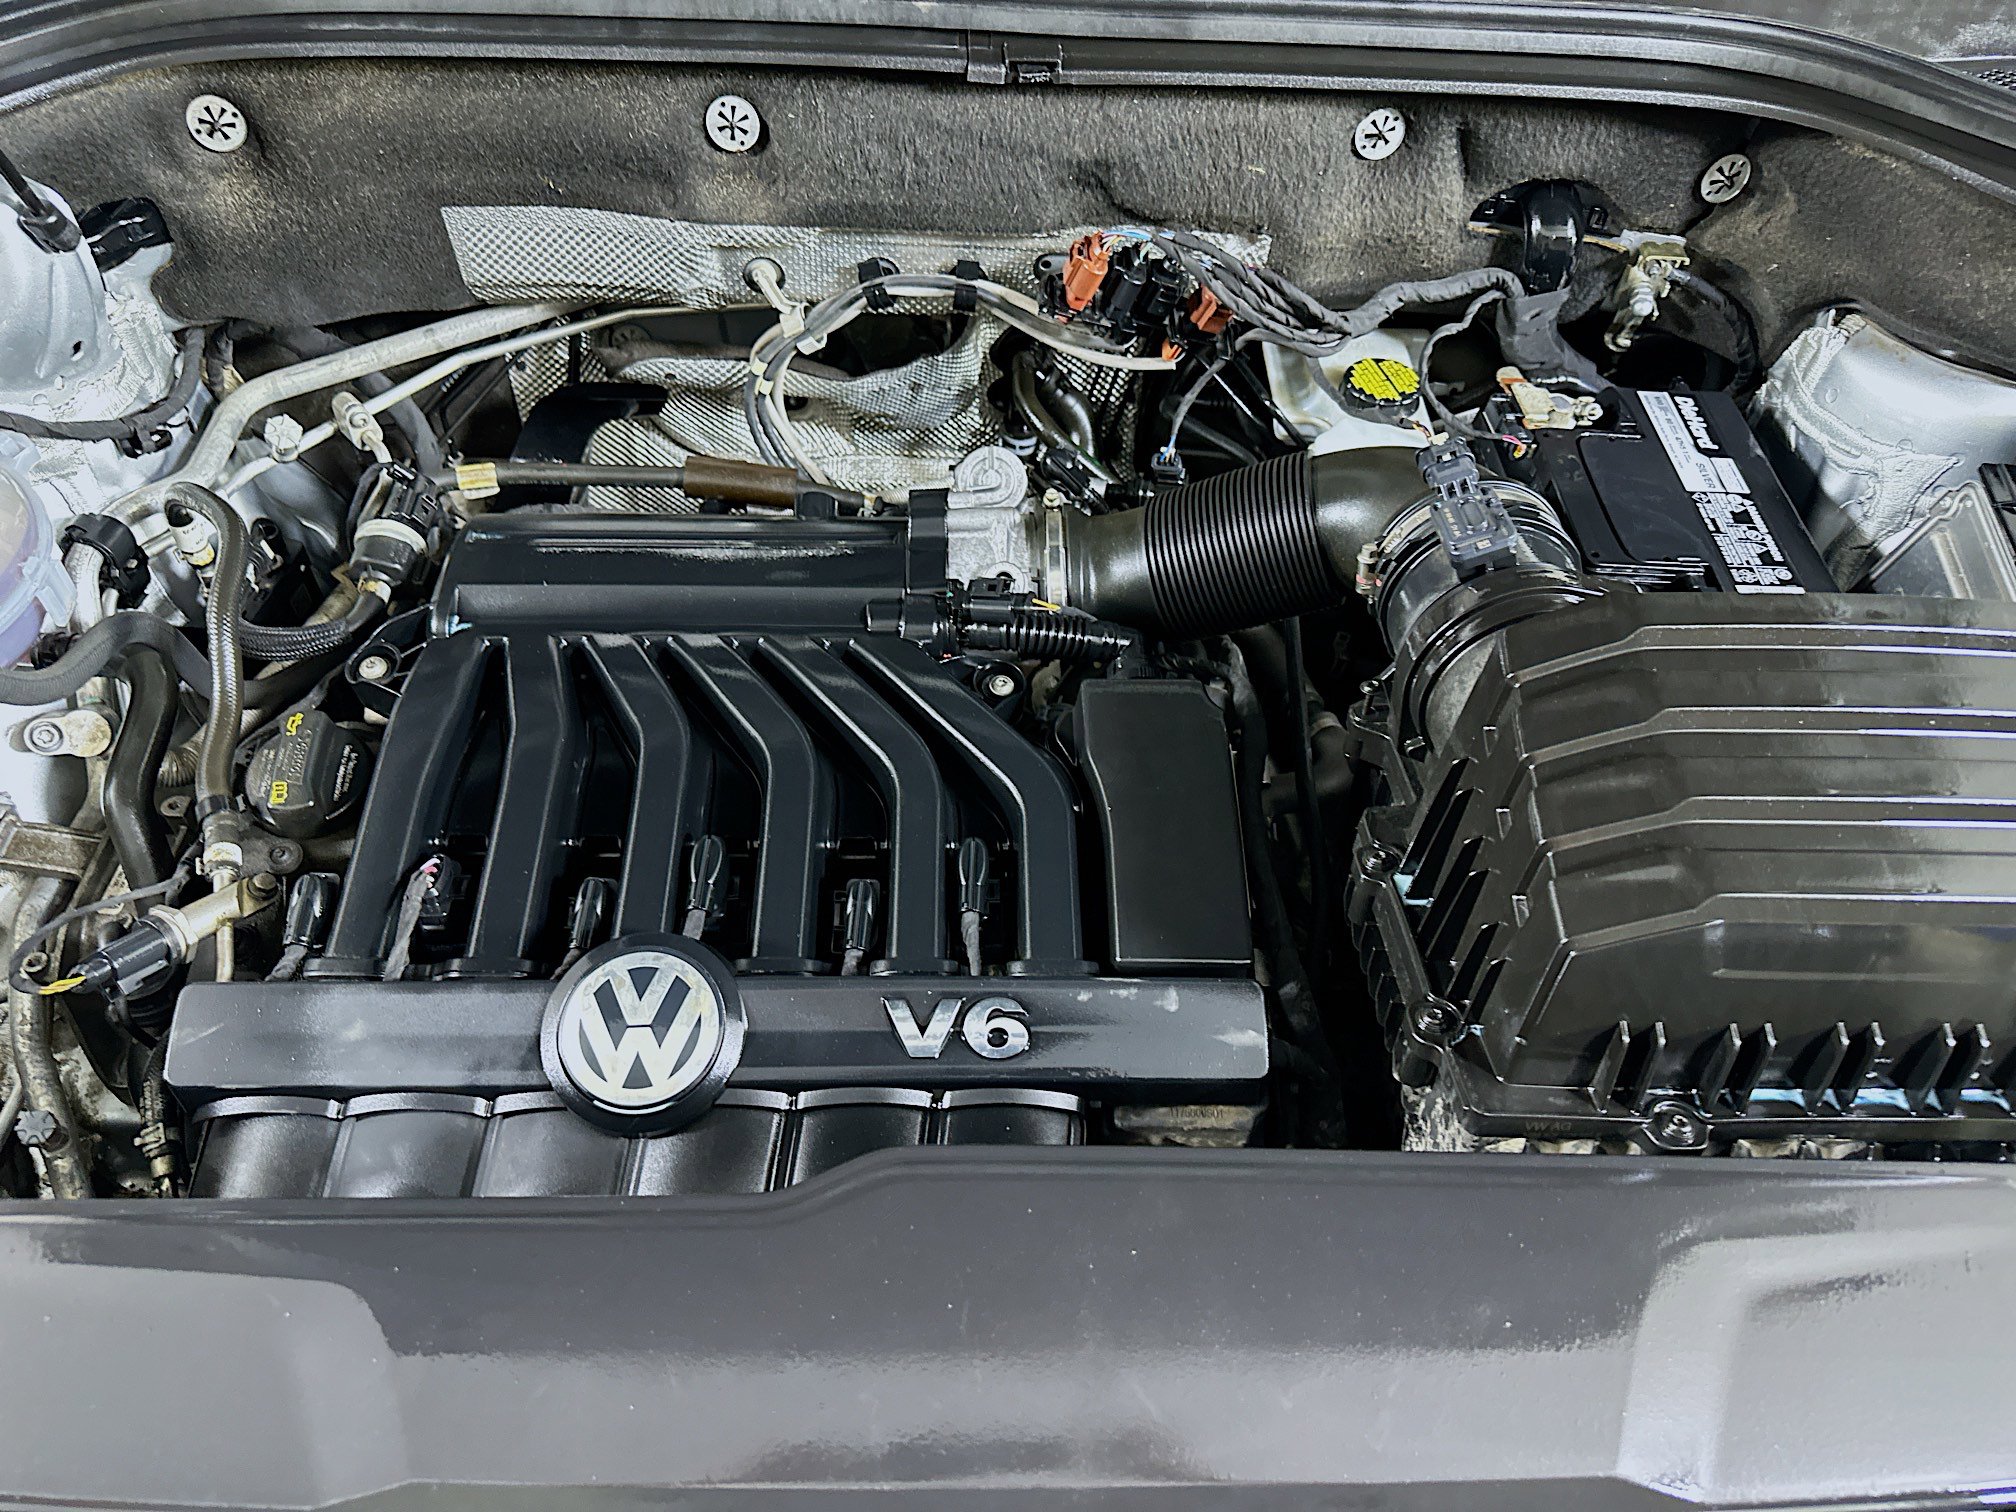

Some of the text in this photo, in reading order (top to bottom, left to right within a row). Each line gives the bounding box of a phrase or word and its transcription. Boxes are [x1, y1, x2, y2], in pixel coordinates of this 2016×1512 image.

[1674, 396, 1719, 450] DieHard
[1695, 462, 1716, 489] SILVER
[566, 955, 717, 1102] VW
[881, 996, 1031, 1059] V6
